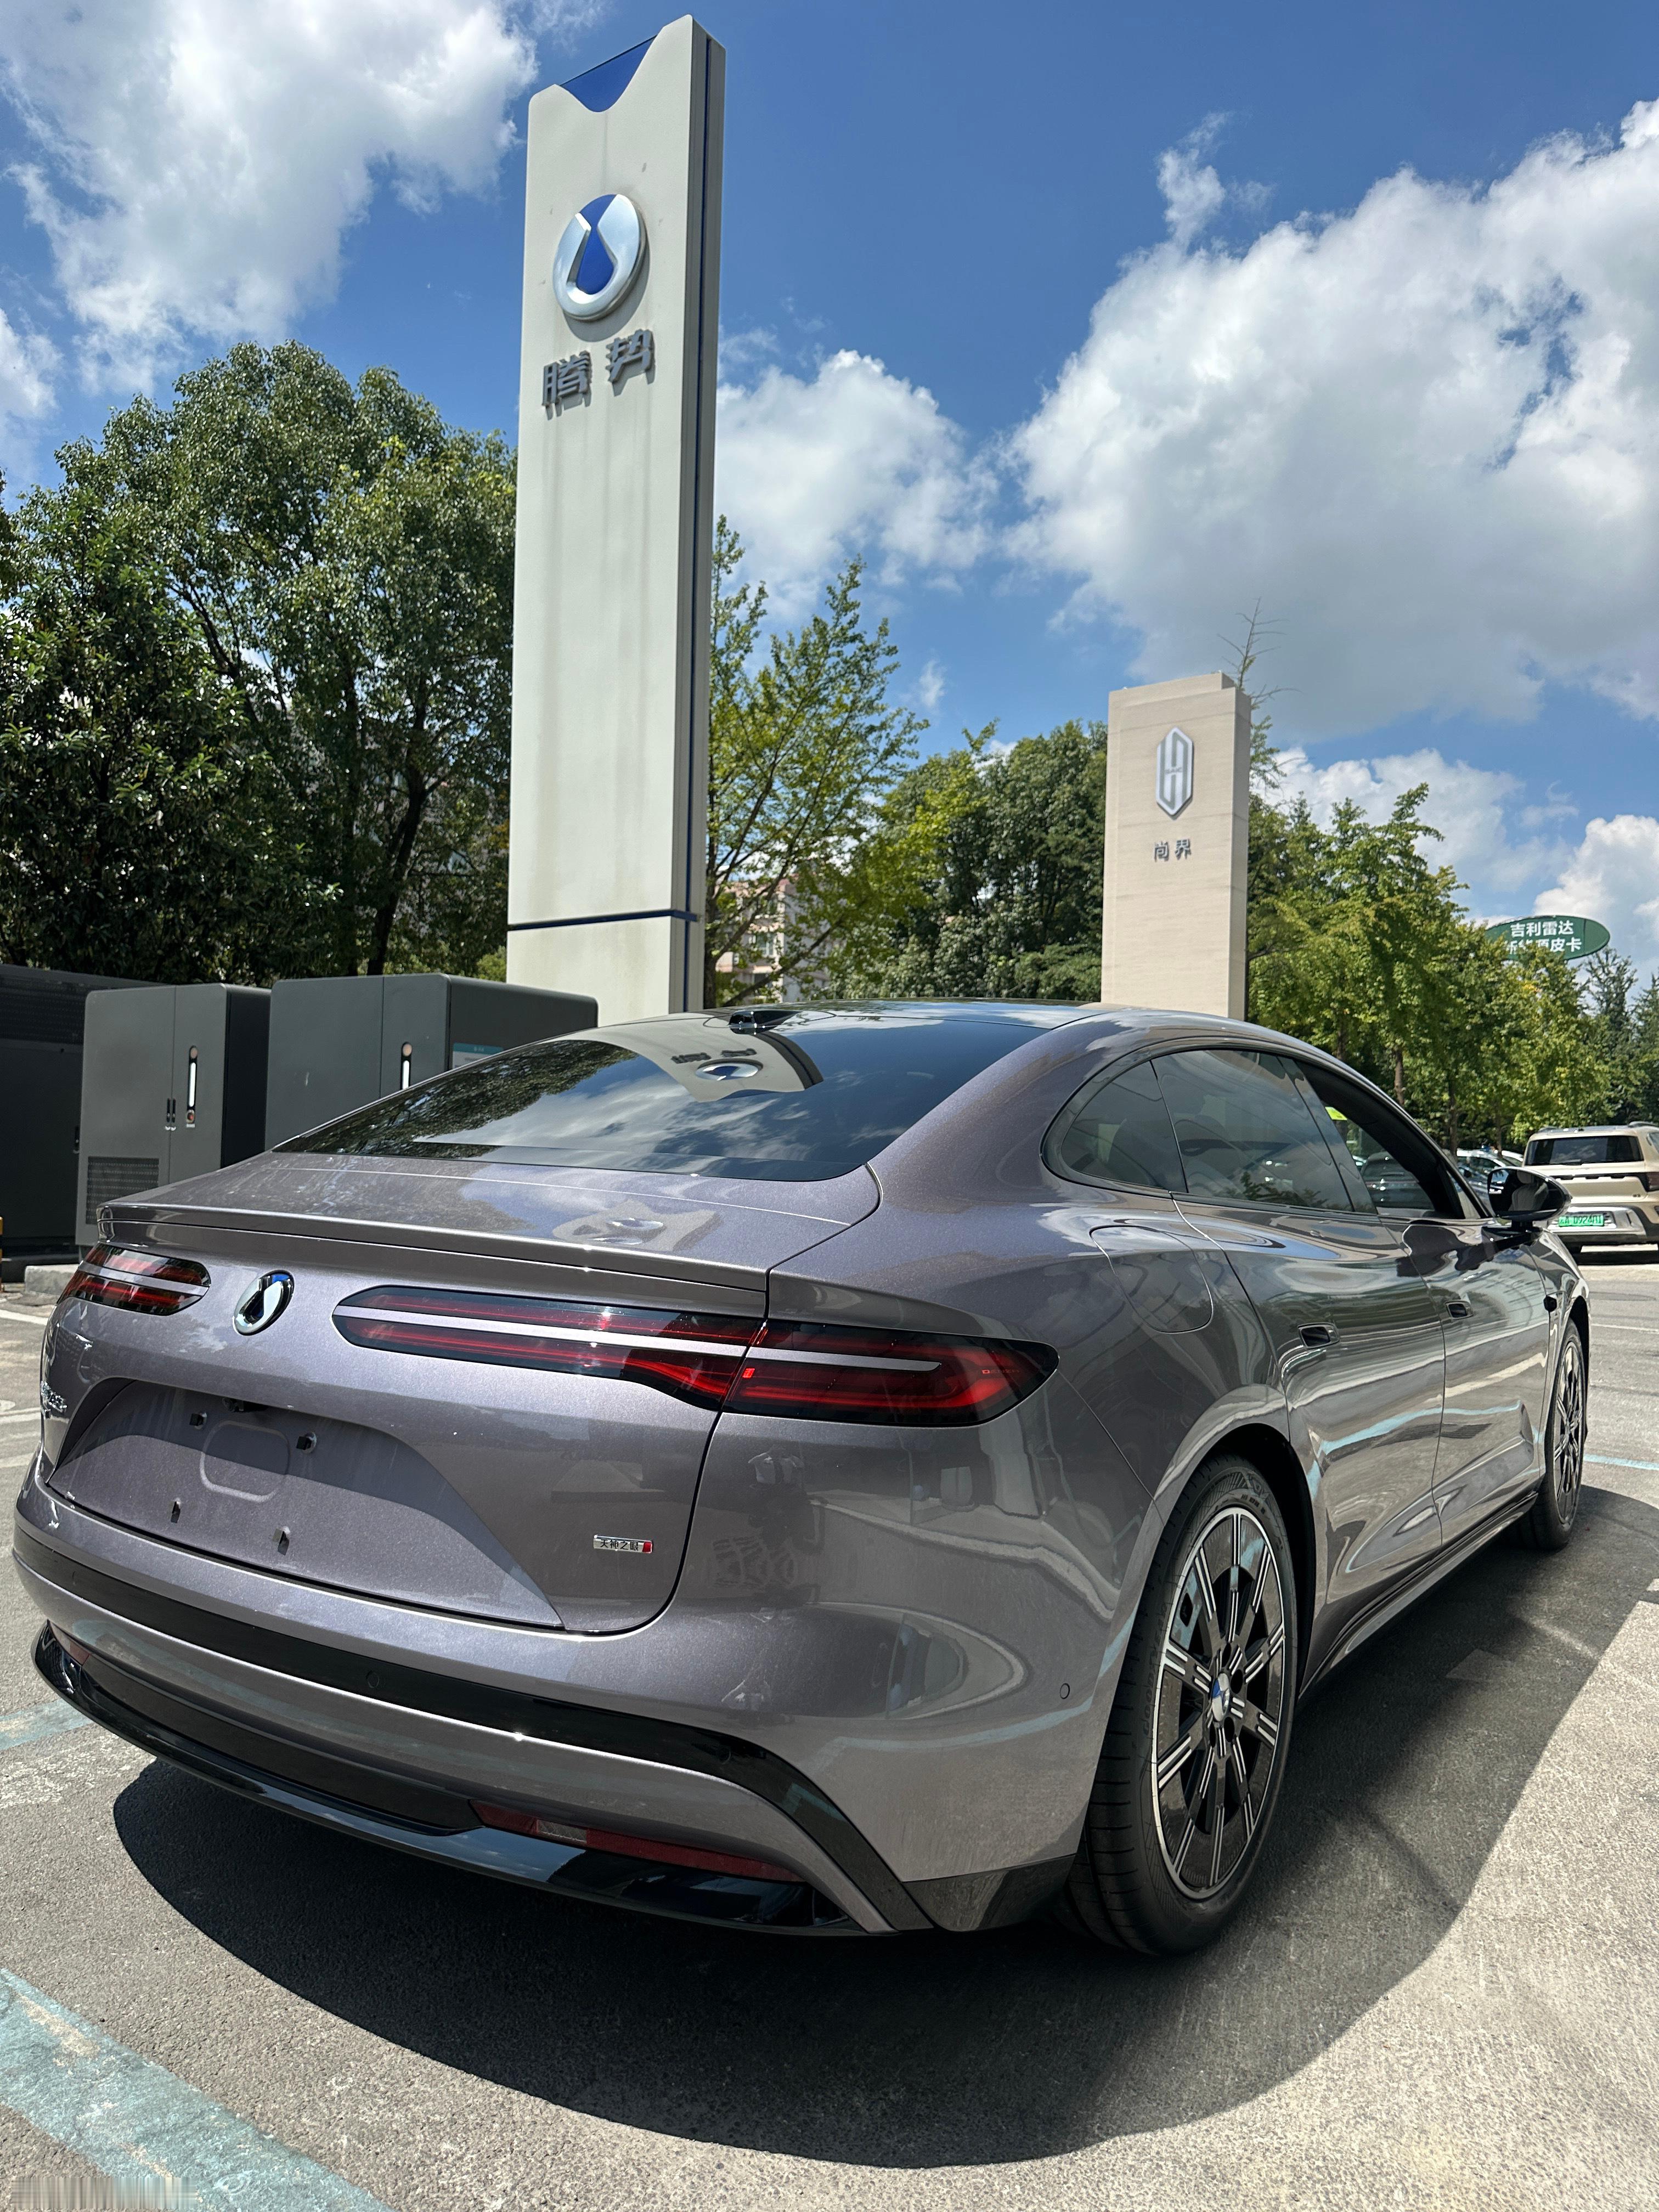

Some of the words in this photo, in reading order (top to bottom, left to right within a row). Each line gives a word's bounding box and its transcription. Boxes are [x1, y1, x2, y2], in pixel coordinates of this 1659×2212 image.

[542, 329, 654, 406] 腾势
[1154, 839, 1191, 861] 尚界
[1510, 920, 1574, 937] 吉利雷达
[600, 1538, 639, 1551] 天神之眼
